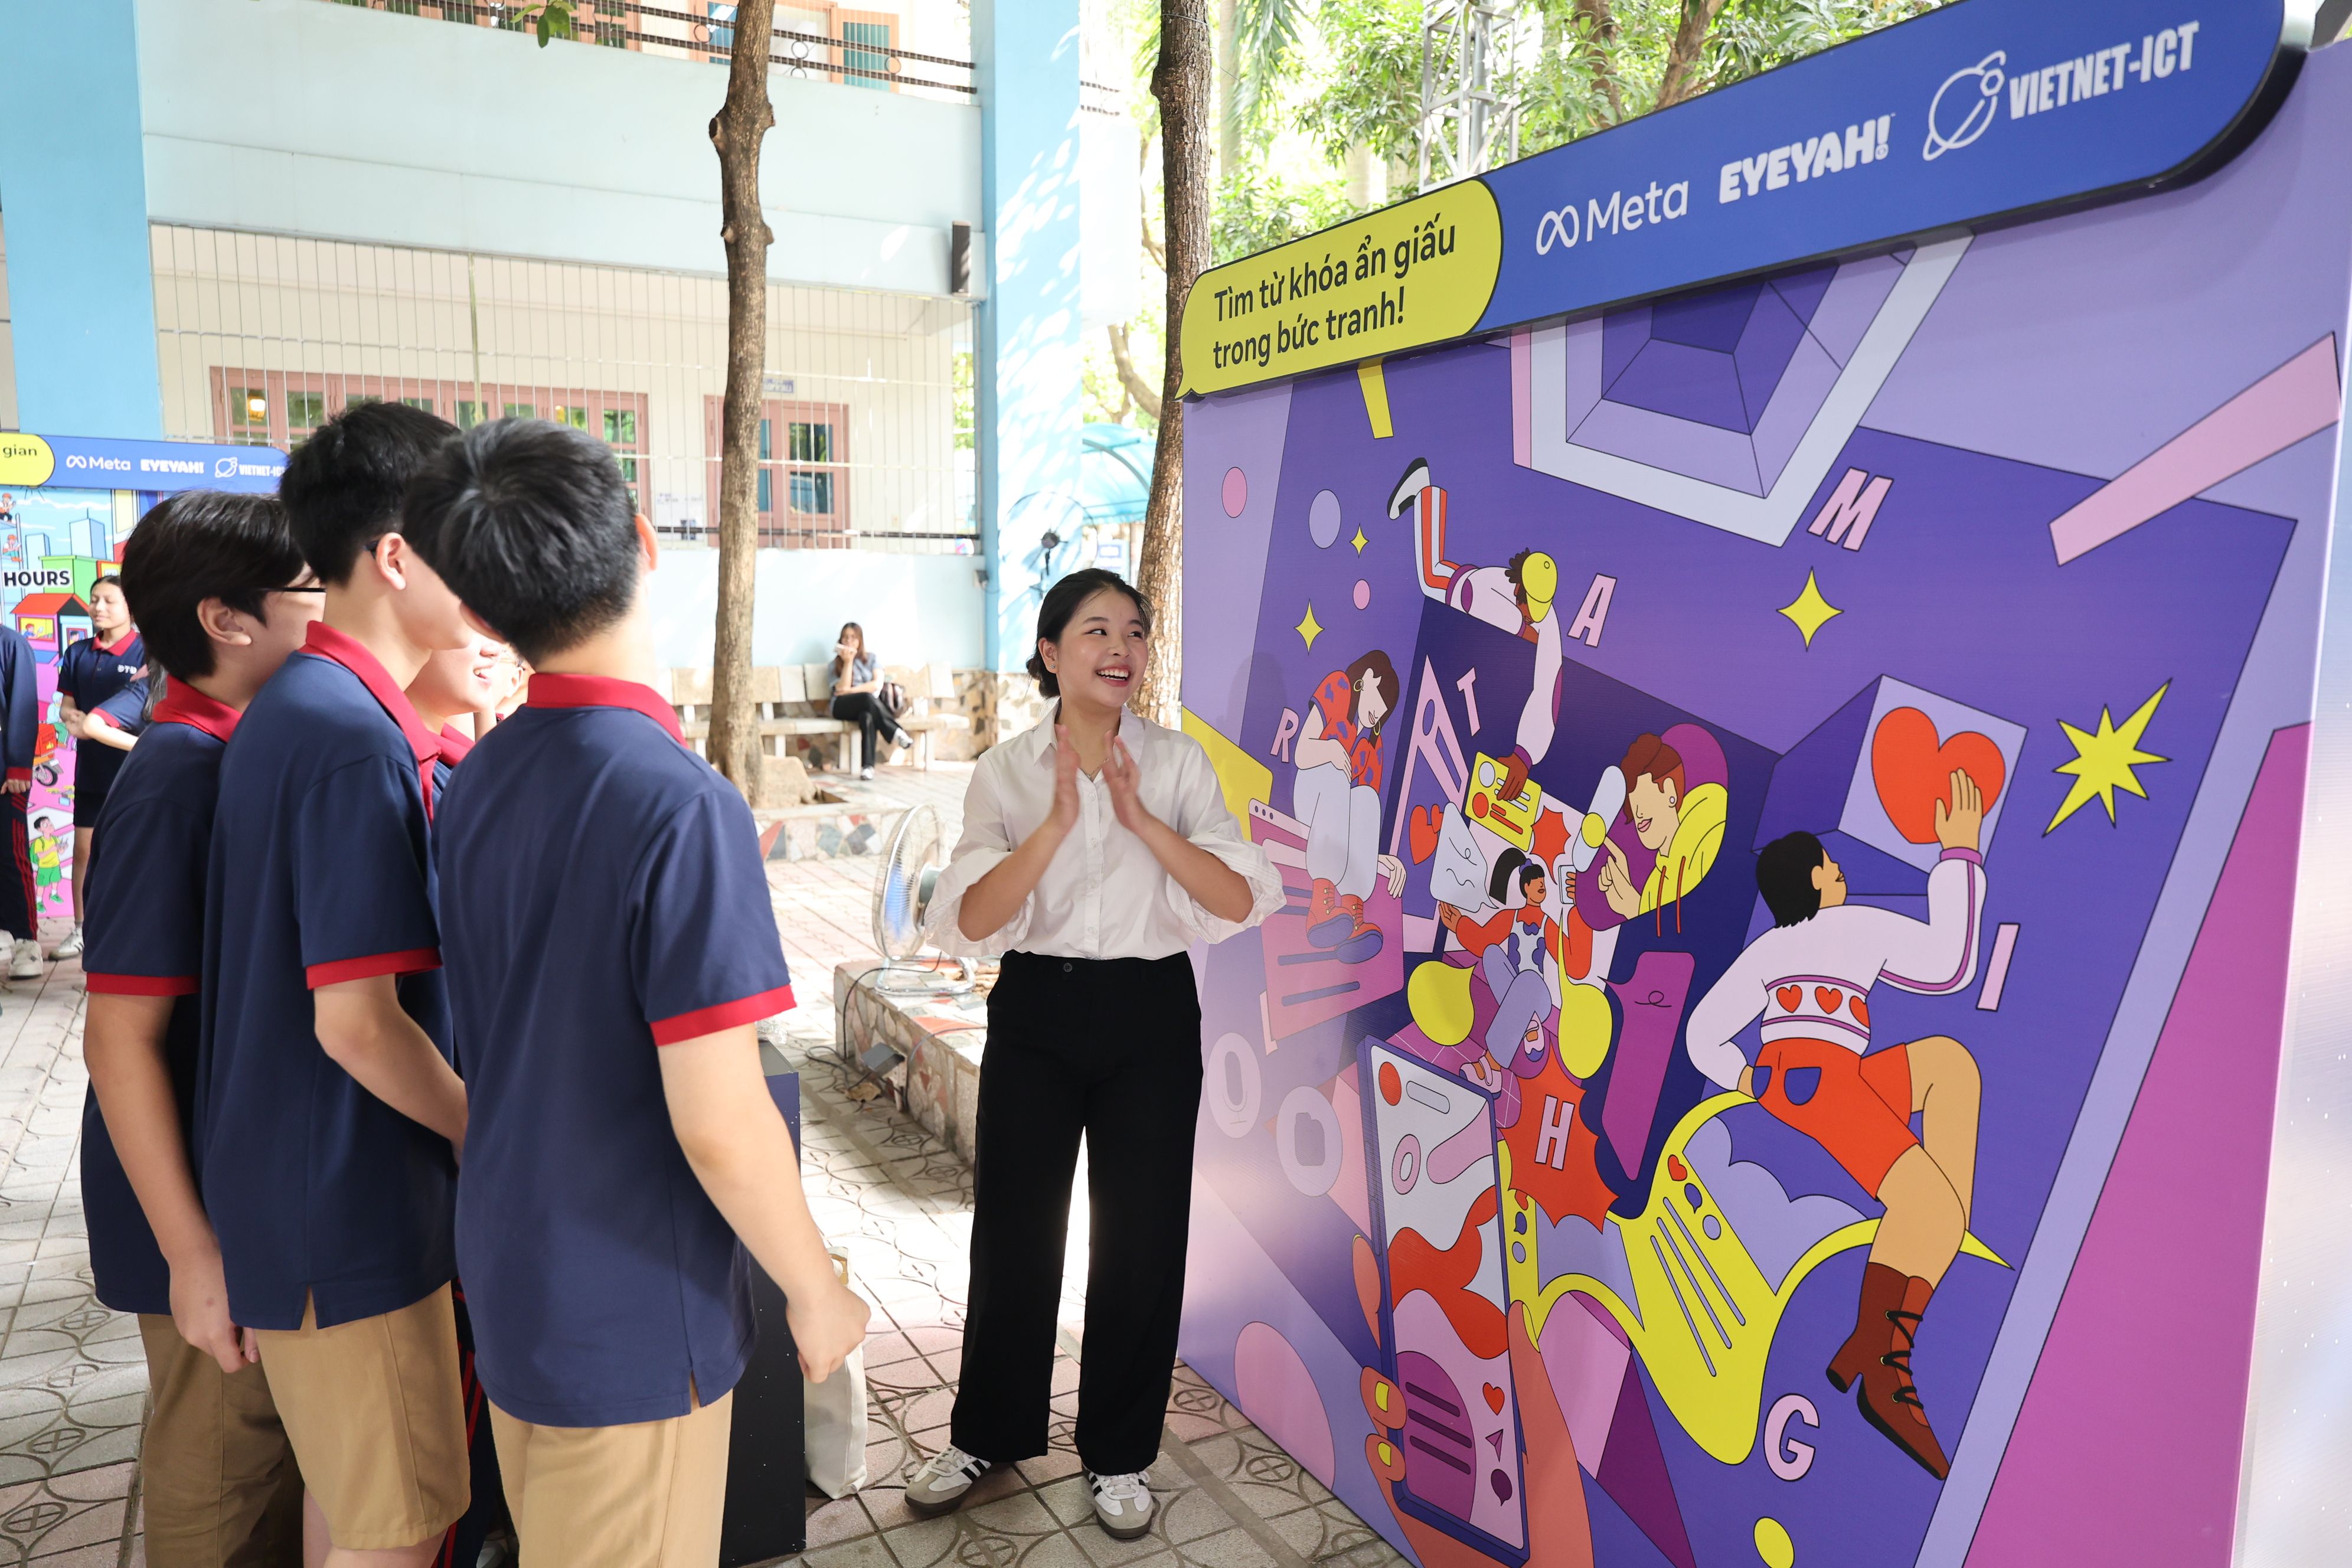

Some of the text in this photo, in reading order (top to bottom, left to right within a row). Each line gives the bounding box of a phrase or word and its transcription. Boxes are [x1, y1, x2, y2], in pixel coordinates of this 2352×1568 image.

[1586, 20, 2199, 241] Meta EYEYAH! VIETNET-ICT
[1214, 213, 1455, 321] Tìm từ khóa ẩn giấu
[1213, 286, 1404, 369] trong bức tranh!
[2, 445, 37, 458] gian
[89, 456, 131, 471] Meta
[141, 459, 204, 474] EYEYAH!
[1807, 466, 1894, 552] M
[4, 570, 70, 586] HOURS
[1567, 573, 1617, 648] A
[1270, 707, 1299, 763] R
[1456, 667, 1481, 737] T
[1535, 1095, 1575, 1171] H
[1763, 1393, 1820, 1482] G
